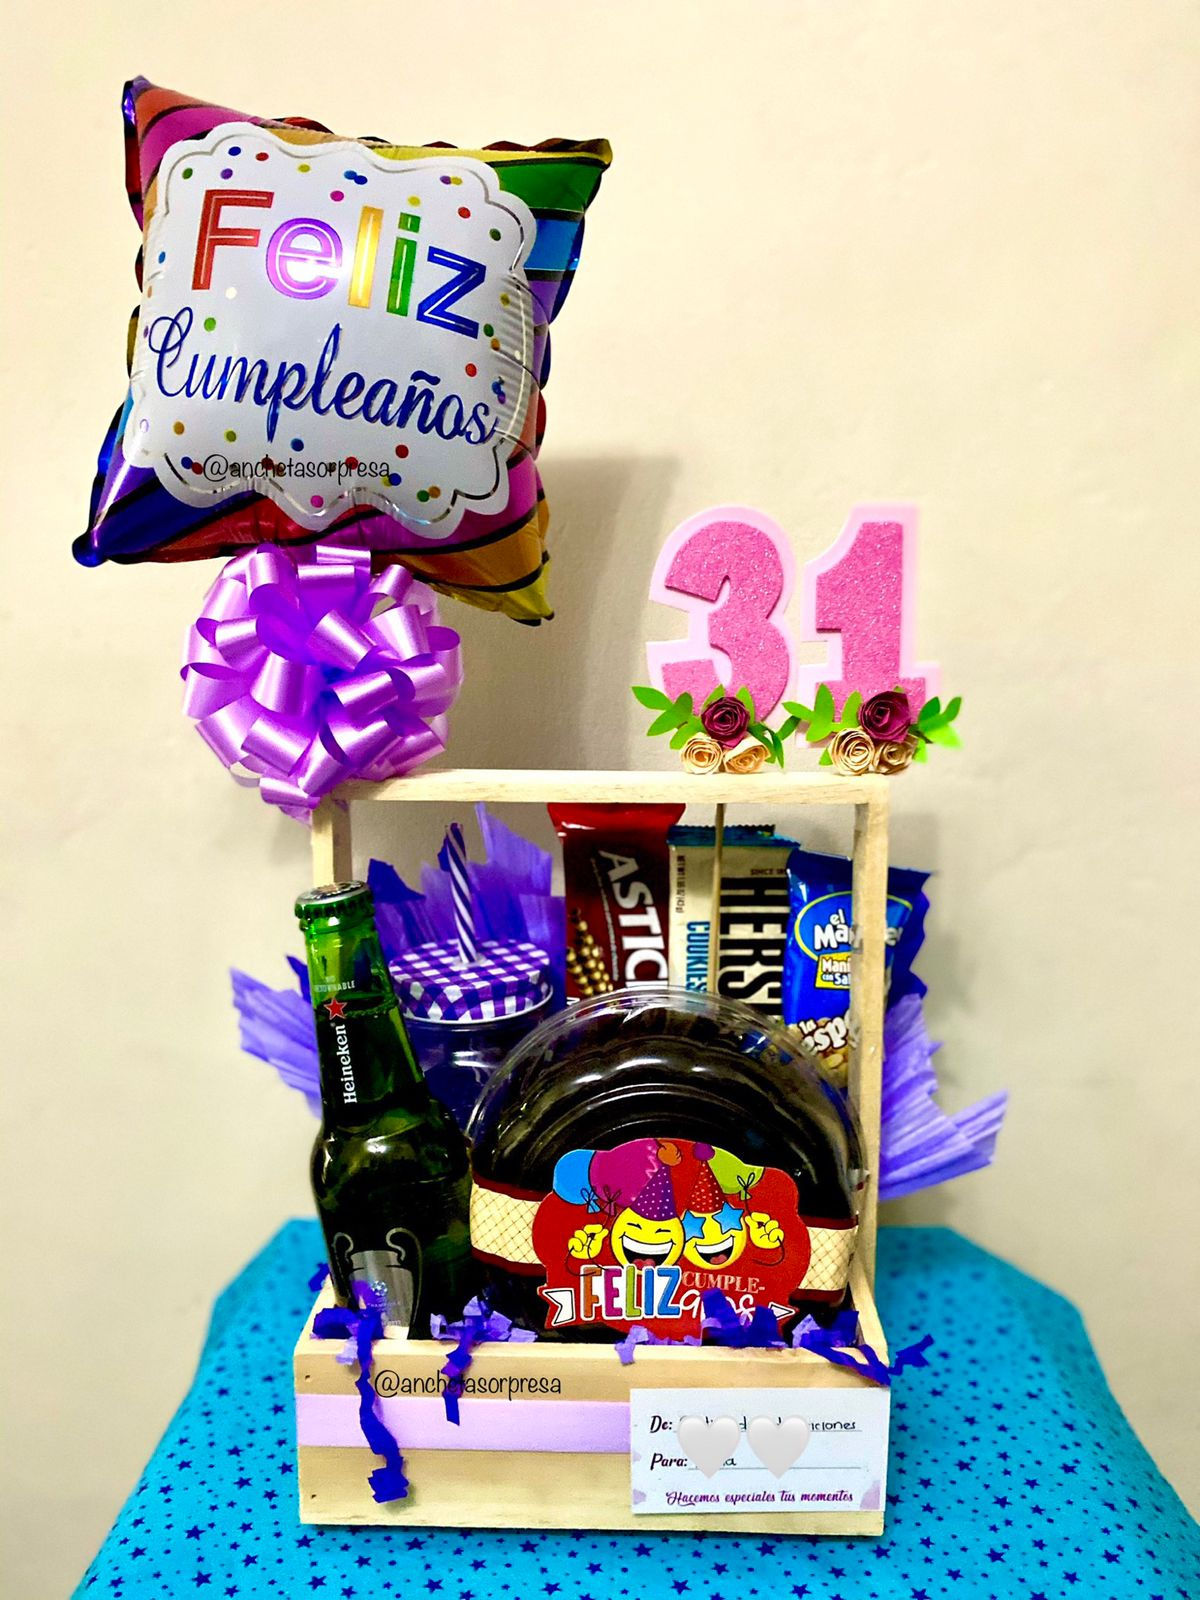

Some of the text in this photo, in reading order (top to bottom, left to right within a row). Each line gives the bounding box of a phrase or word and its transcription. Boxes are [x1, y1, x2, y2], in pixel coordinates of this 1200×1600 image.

[191, 189, 487, 339] Feliz
[148, 306, 499, 444] Cumpleaños
[662, 519, 927, 727] 31
[829, 908, 846, 926] el
[335, 1024, 358, 1104] Heineken
[580, 1264, 682, 1320] FELIZ
[682, 1271, 766, 1294] CUMPLE-
[650, 1415, 673, 1433] De:
[650, 1452, 688, 1471] Para:
[666, 1489, 854, 1507] Hacemos especiales tus momentos
